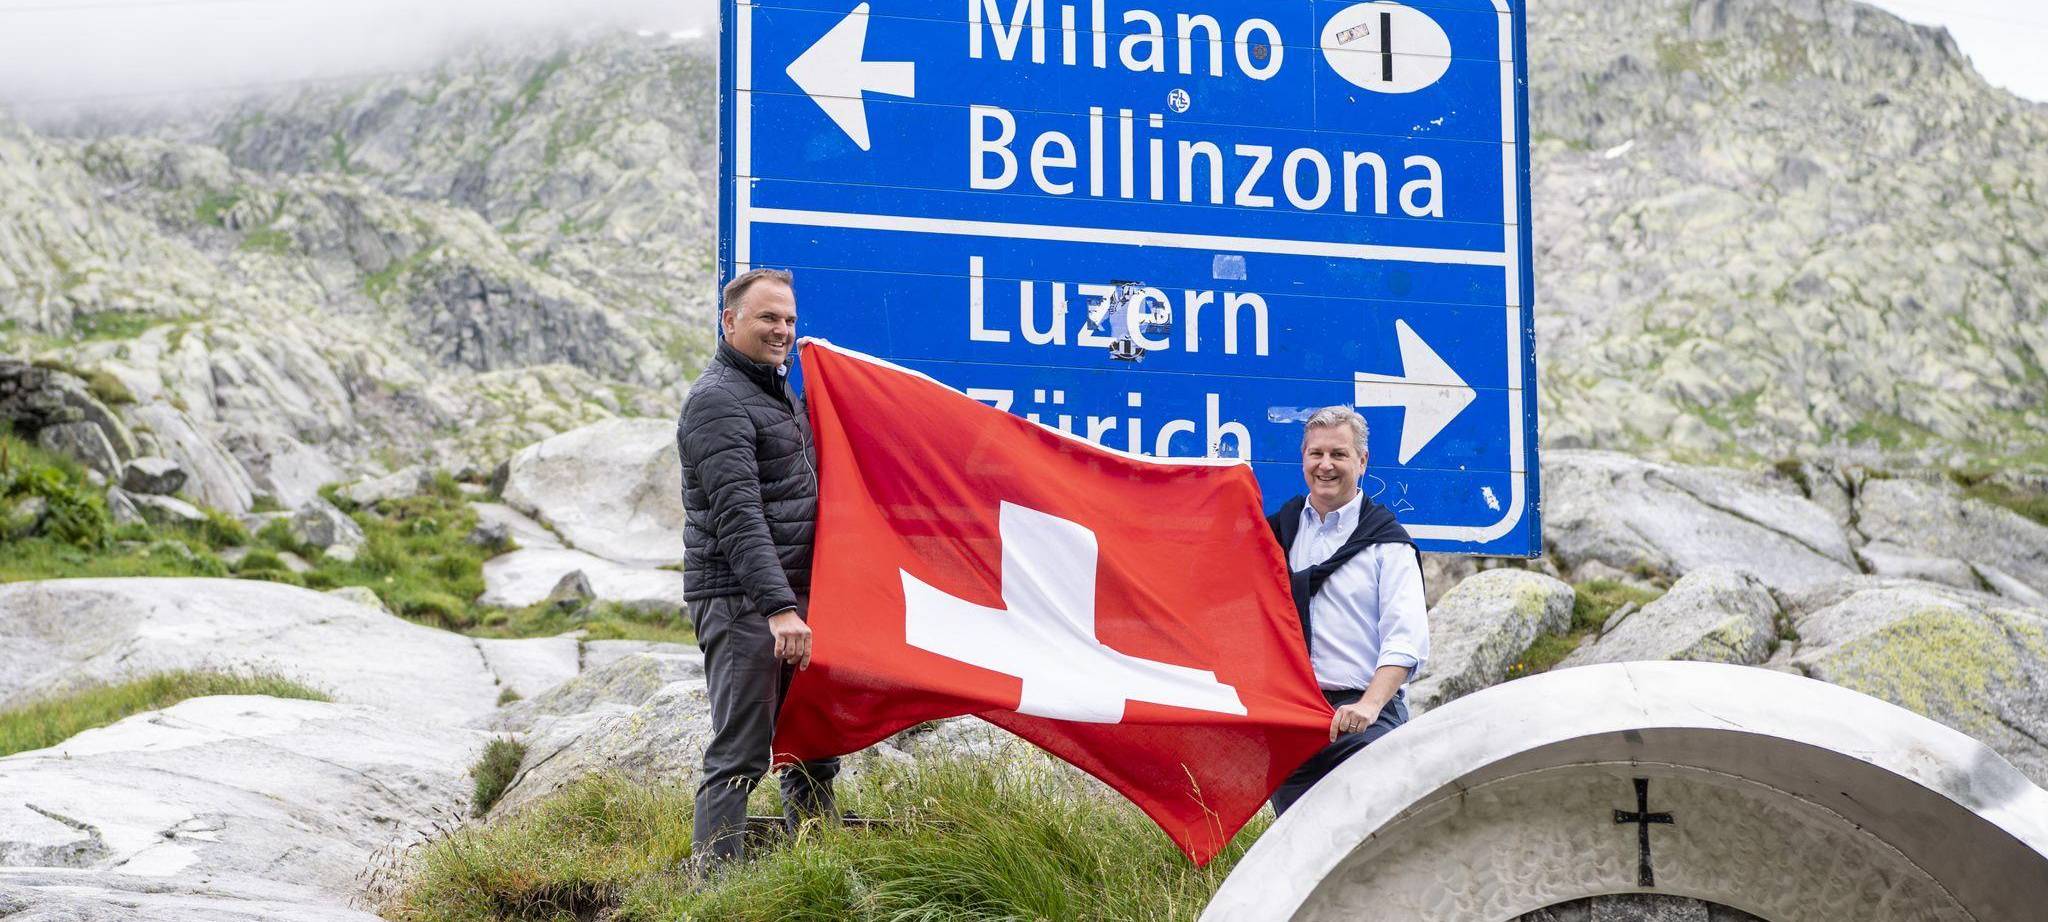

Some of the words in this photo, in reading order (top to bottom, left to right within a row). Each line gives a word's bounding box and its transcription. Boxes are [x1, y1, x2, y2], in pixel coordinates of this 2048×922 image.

[968, 0, 1284, 81] Milano
[1380, 12, 1393, 82] I
[969, 105, 1444, 218] Bellinzona
[969, 255, 1269, 356] Luzern
